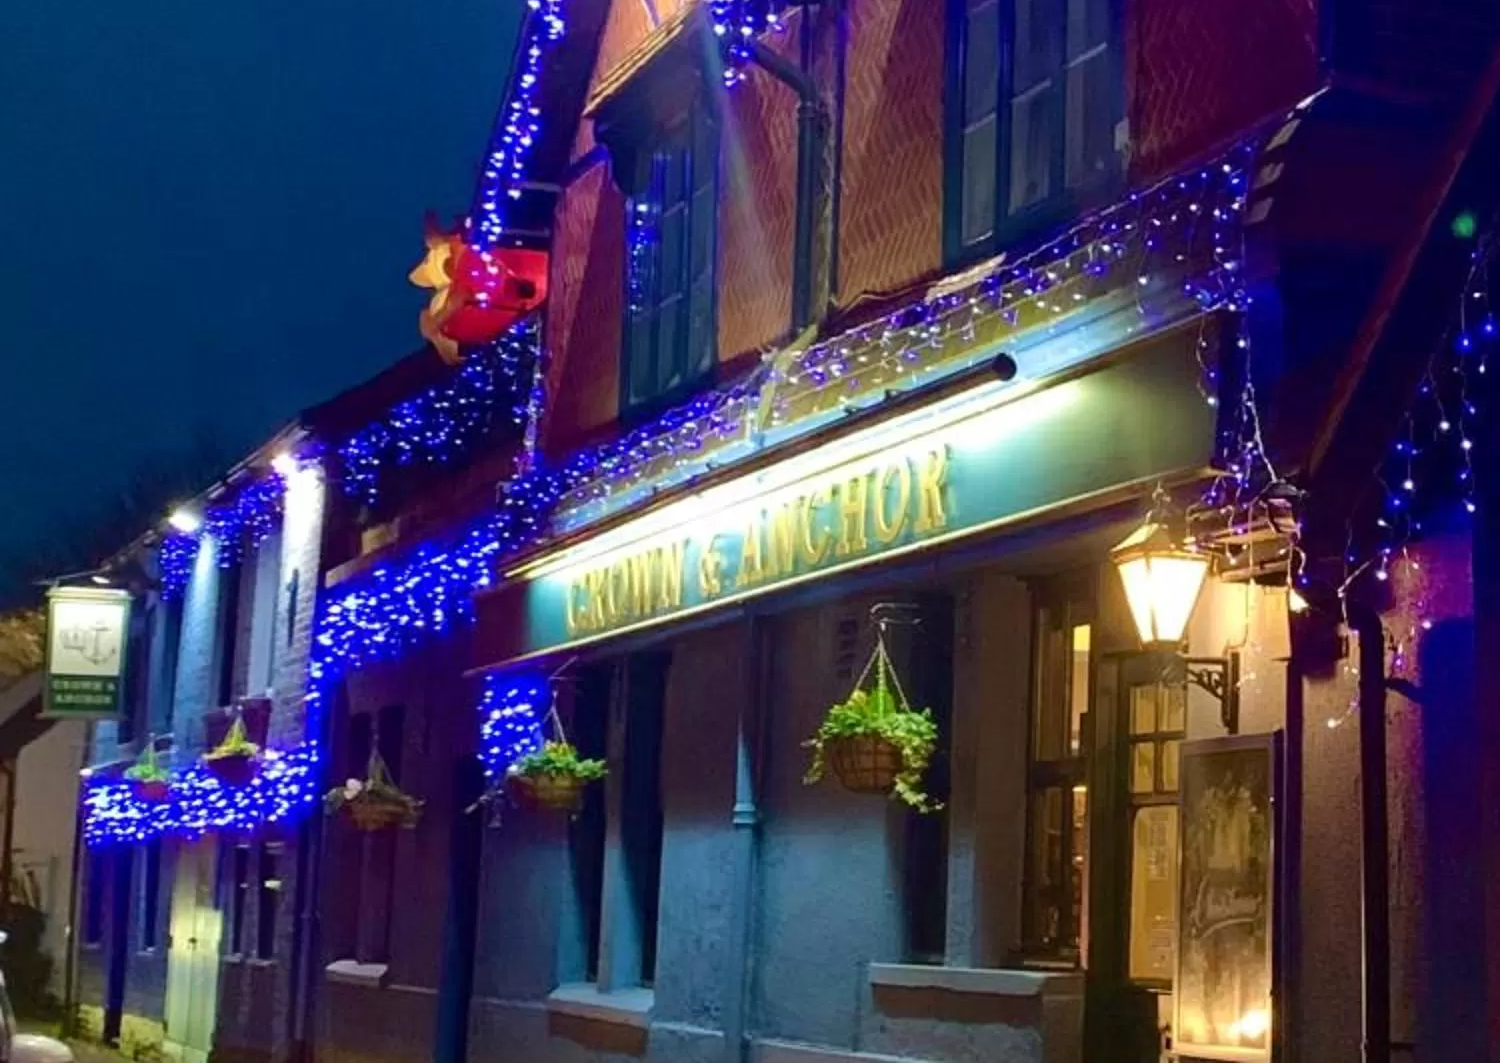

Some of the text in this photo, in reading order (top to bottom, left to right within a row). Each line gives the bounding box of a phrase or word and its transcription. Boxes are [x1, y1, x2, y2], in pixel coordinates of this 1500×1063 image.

[567, 445, 952, 635] CROWN & ANCHOR
